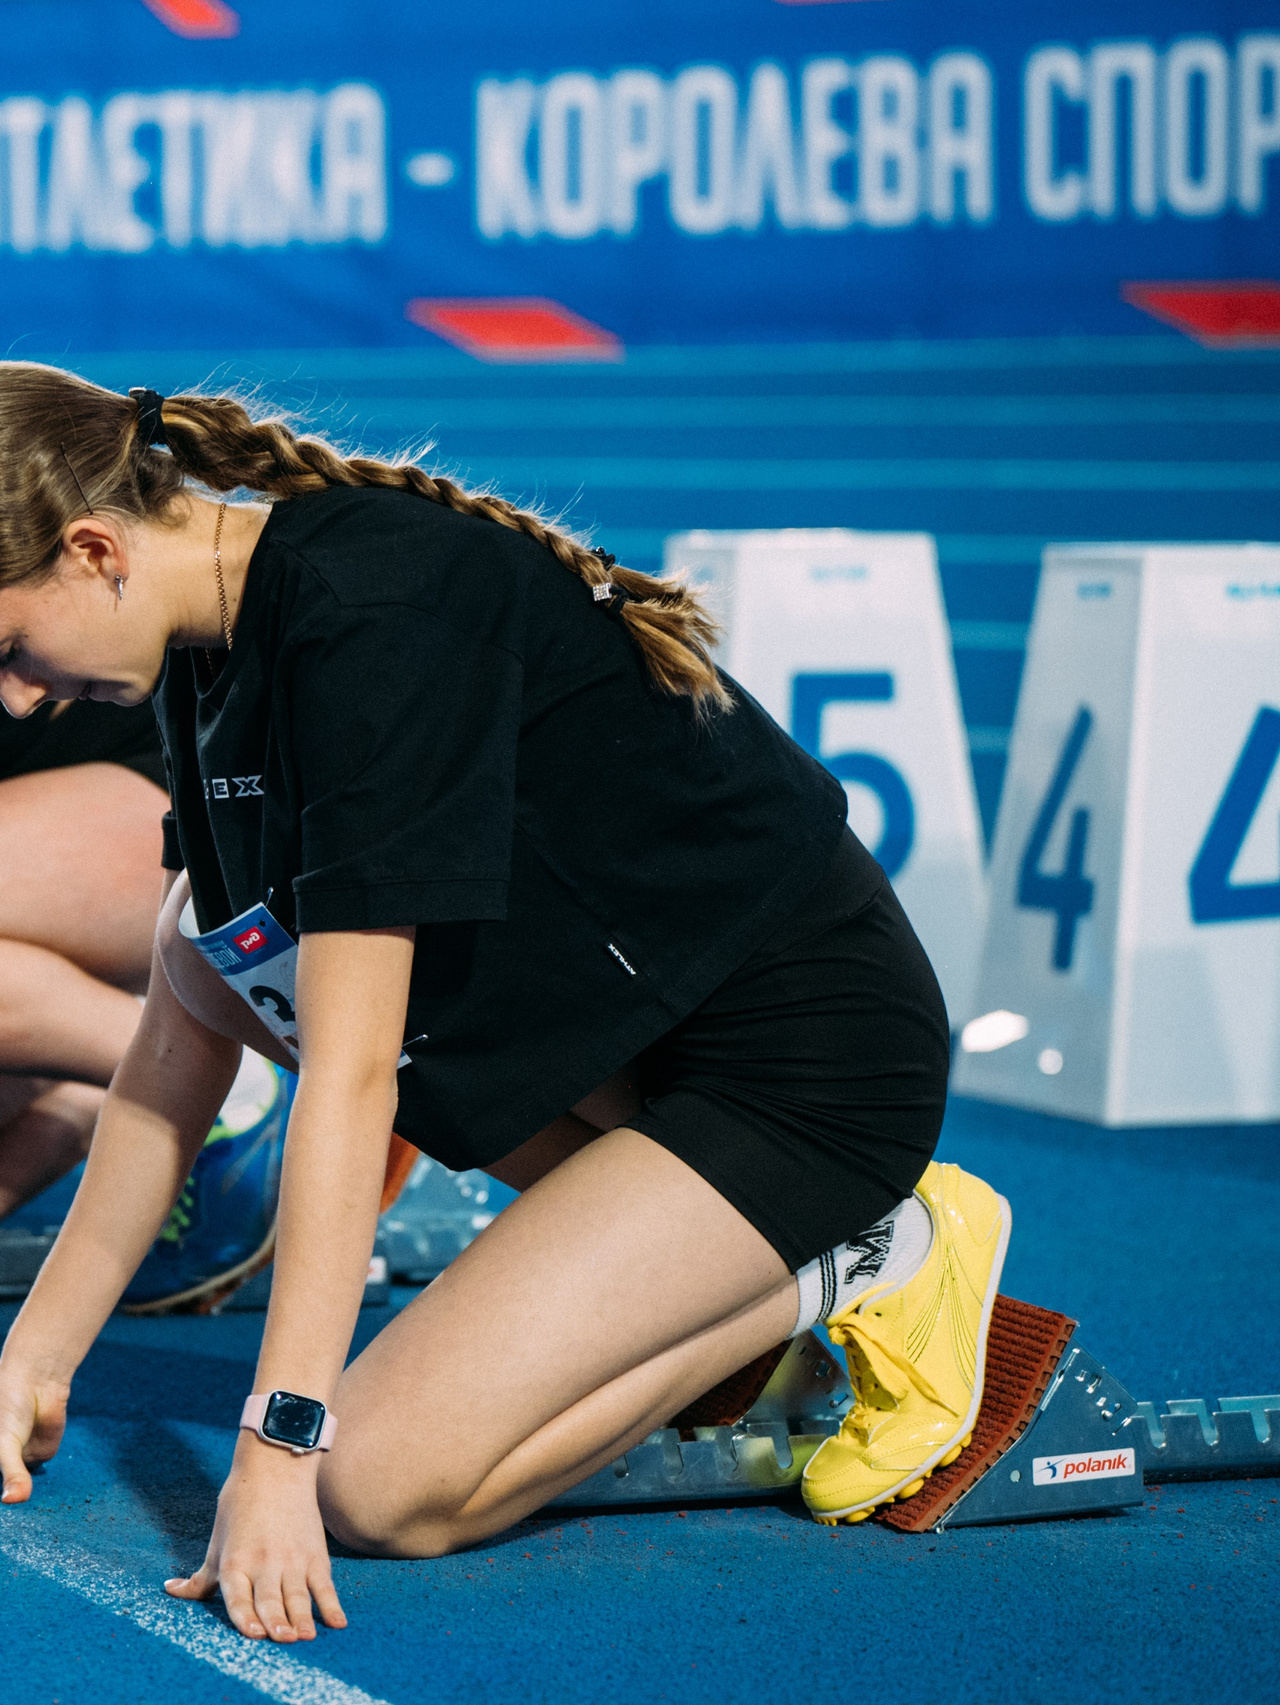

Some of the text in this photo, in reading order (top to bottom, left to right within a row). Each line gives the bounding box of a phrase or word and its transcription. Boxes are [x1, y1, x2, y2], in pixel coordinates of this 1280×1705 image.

[477, 48, 994, 238] КОРОЛЕВА
[1024, 34, 1280, 221] СПОР
[790, 669, 917, 884] 5
[1014, 703, 1096, 974] 4
